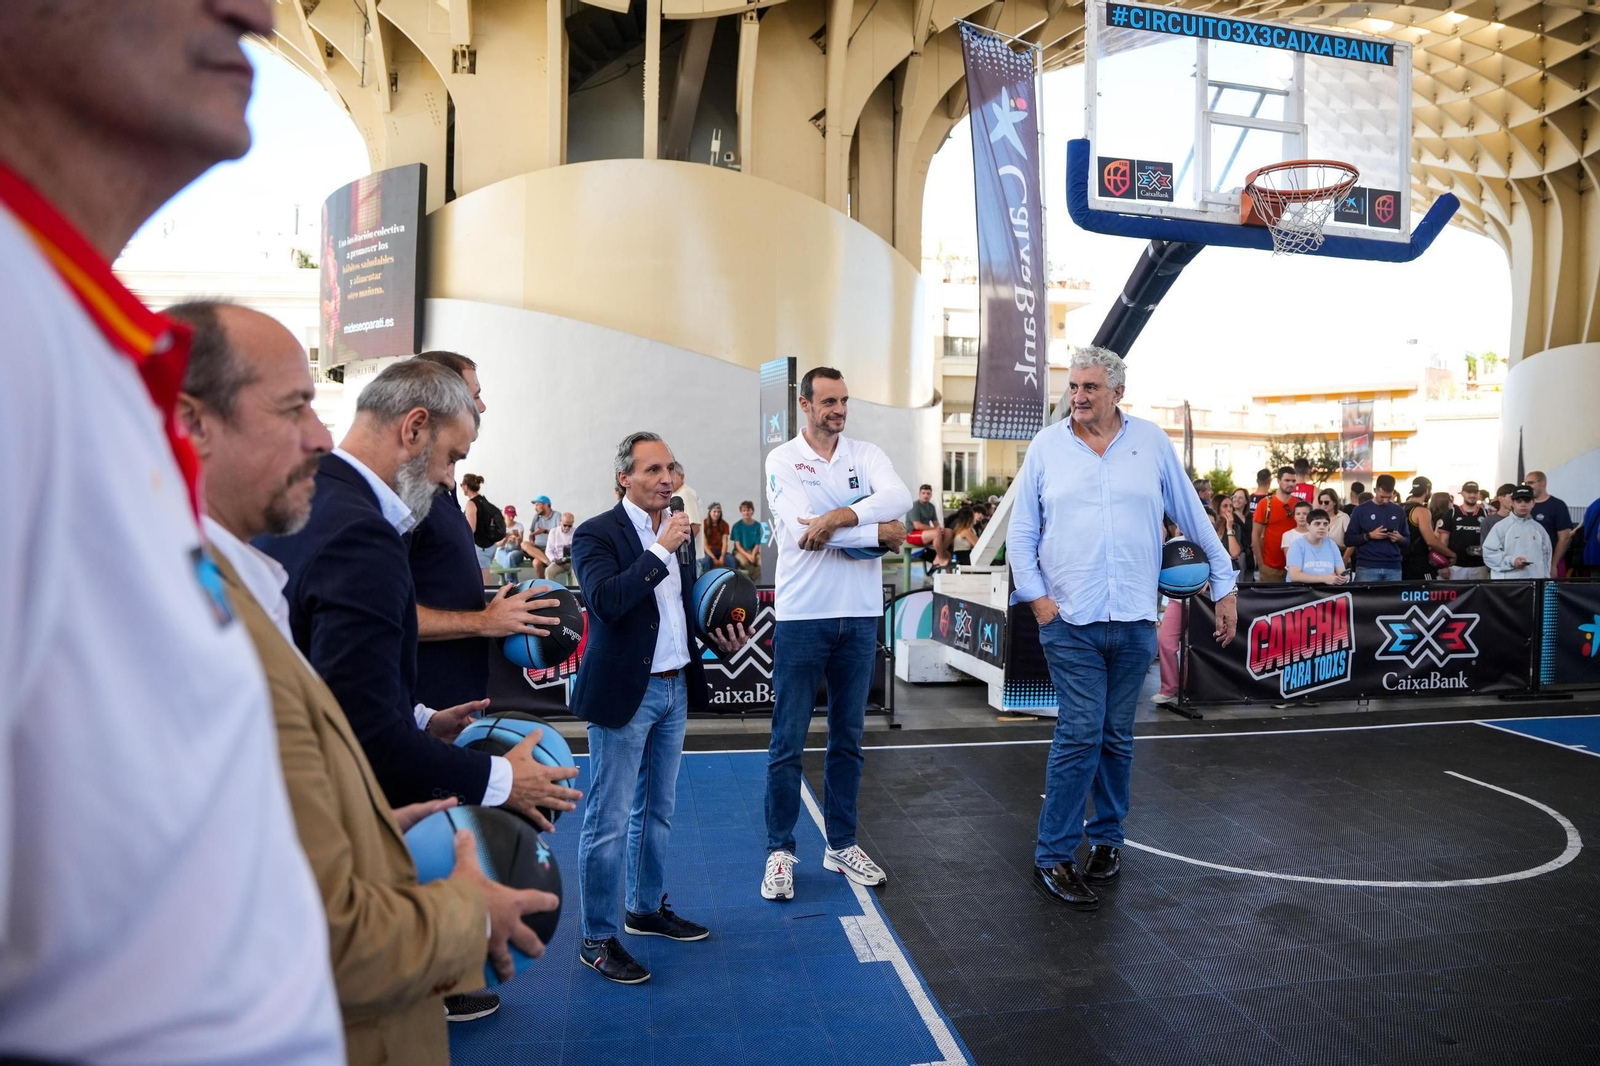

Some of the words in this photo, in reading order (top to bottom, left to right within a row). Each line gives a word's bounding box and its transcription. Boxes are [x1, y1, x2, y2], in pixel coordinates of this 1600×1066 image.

[1112, 6, 1389, 64] #CIRCUITO3X3CAIXABANK
[1140, 189, 1169, 198] CaixaBank
[373, 223, 405, 237] colectiva
[350, 244, 378, 260] promover
[378, 241, 389, 251] los
[360, 254, 395, 269] saludables
[1401, 590, 1457, 601] CIRCUITO
[1250, 596, 1349, 674] CANCHA
[1283, 659, 1311, 692] PARA
[1314, 650, 1346, 682] TODXS
[1382, 670, 1469, 691] CaixaBank
